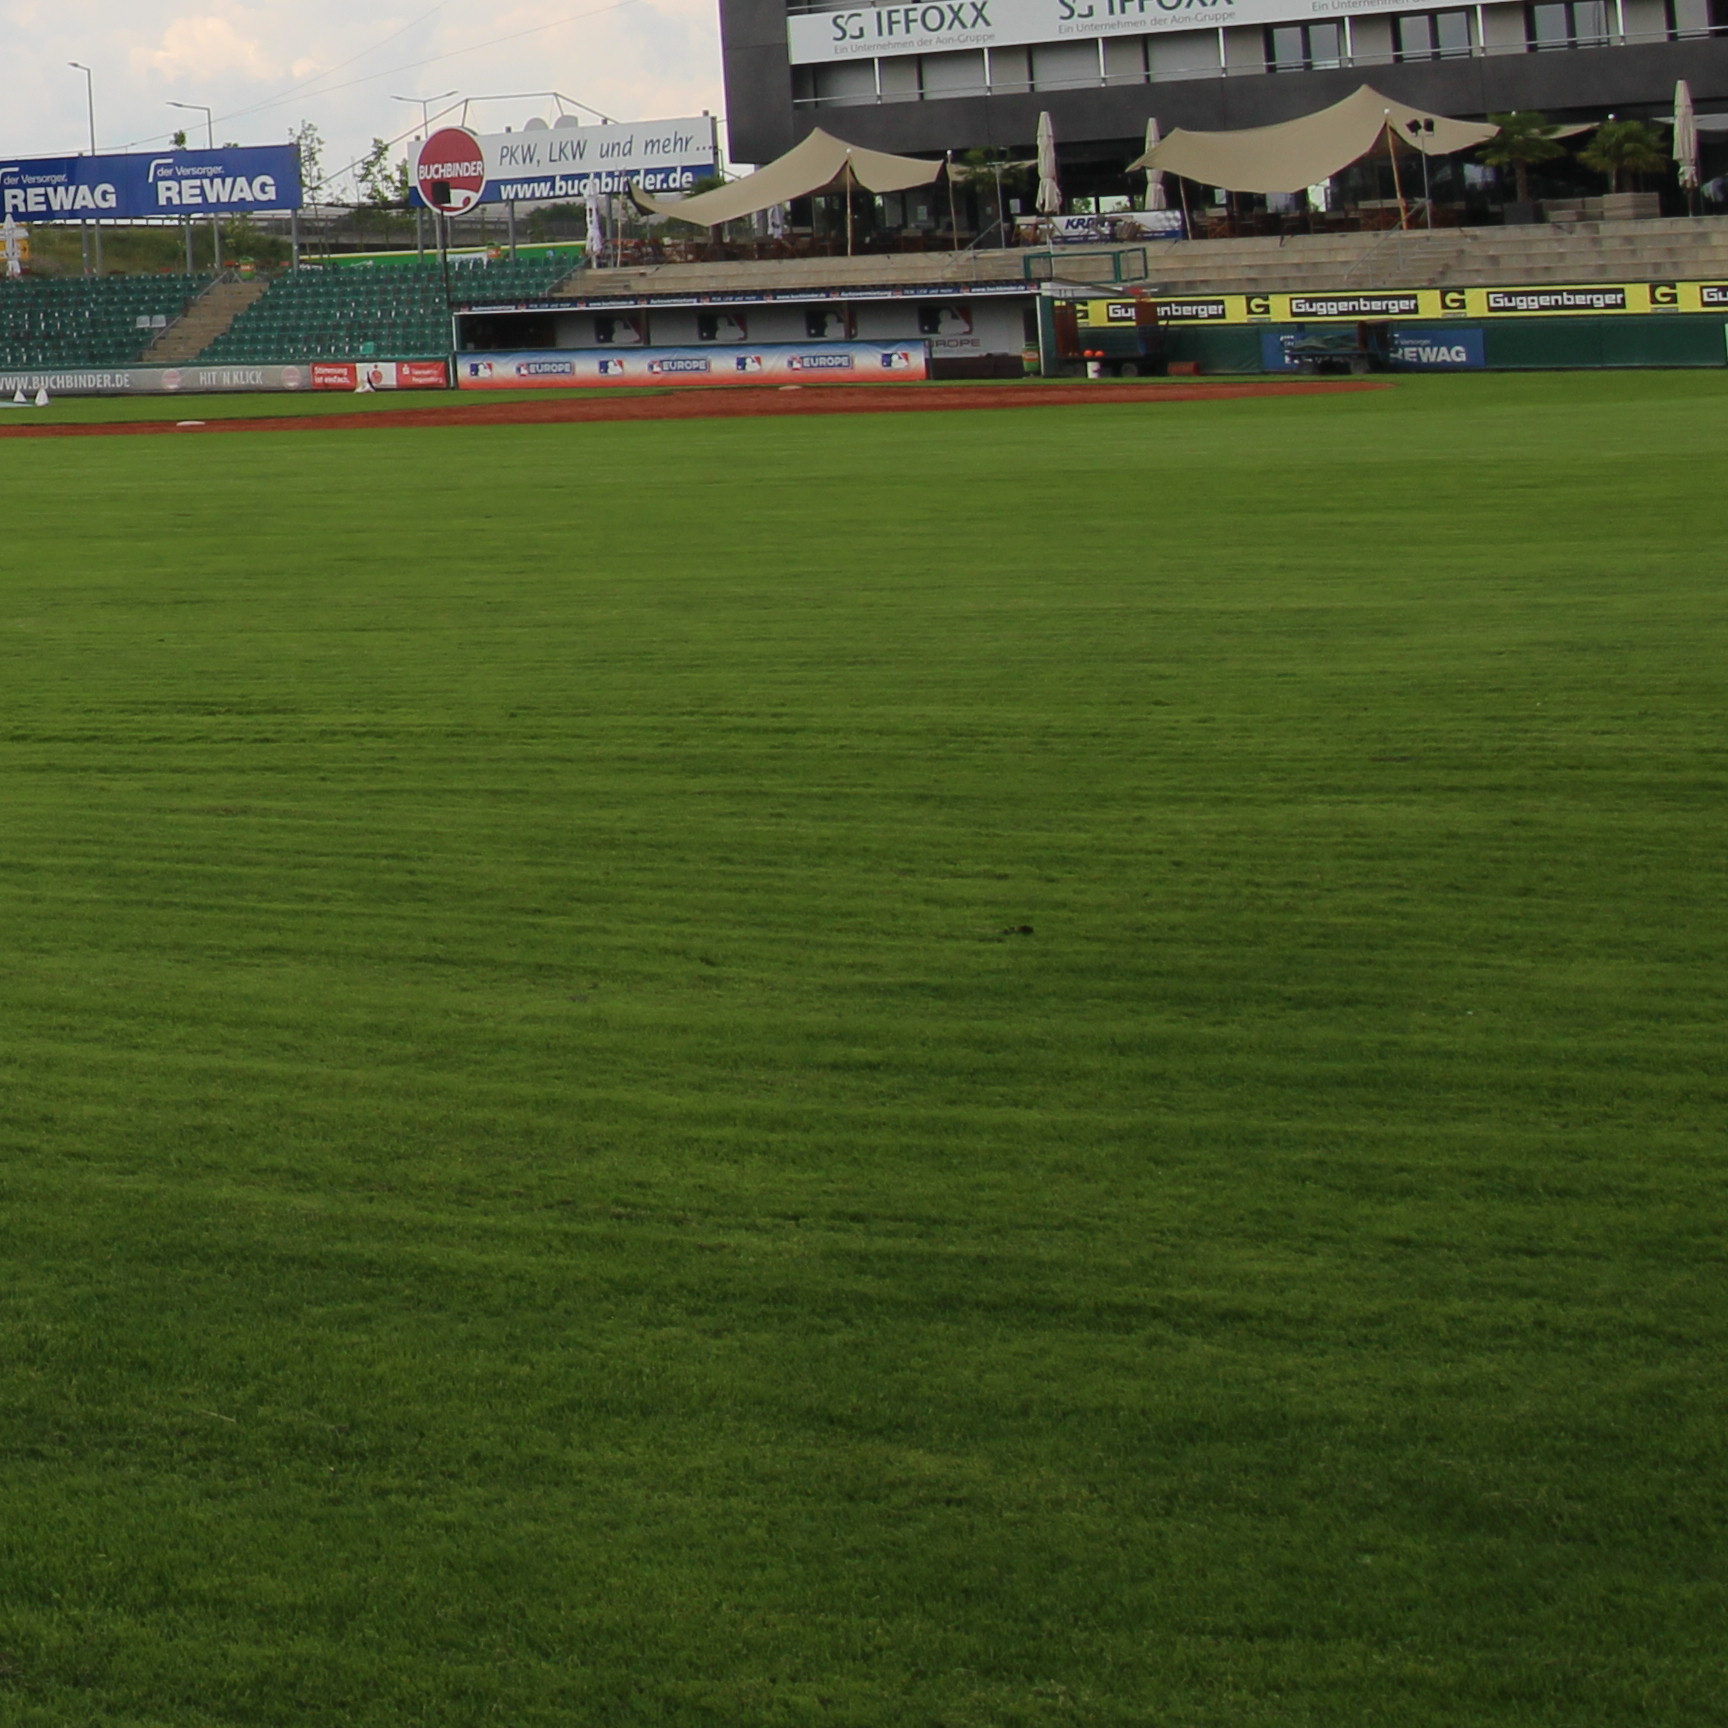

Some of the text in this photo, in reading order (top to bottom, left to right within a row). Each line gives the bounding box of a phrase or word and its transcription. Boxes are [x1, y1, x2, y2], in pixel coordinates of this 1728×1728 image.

[1311, 1, 1327, 12] Ein
[876, 0, 992, 37] IFFOXX
[1058, 10, 1236, 34] Ein Unternehmen der Aon-Gruppe
[834, 33, 995, 55] Ein Unternehmen der Aon-Gruppe
[499, 144, 541, 167] PKW,
[549, 140, 587, 162] LKW
[600, 135, 633, 159] und
[644, 134, 694, 154] mehr
[156, 166, 174, 176] der
[419, 161, 483, 180] BUCHBINDER
[3, 176, 19, 186] der
[4, 183, 117, 212] REWAG
[157, 175, 277, 206] REWAG
[1292, 297, 1417, 314] Guggenberger
[1489, 292, 1623, 309] Guggenberger
[529, 363, 571, 374] EUROPE
[662, 359, 706, 371] EUROPE
[802, 356, 849, 367] EUROPE
[199, 372, 217, 385] HIT
[233, 371, 263, 385] KLICK
